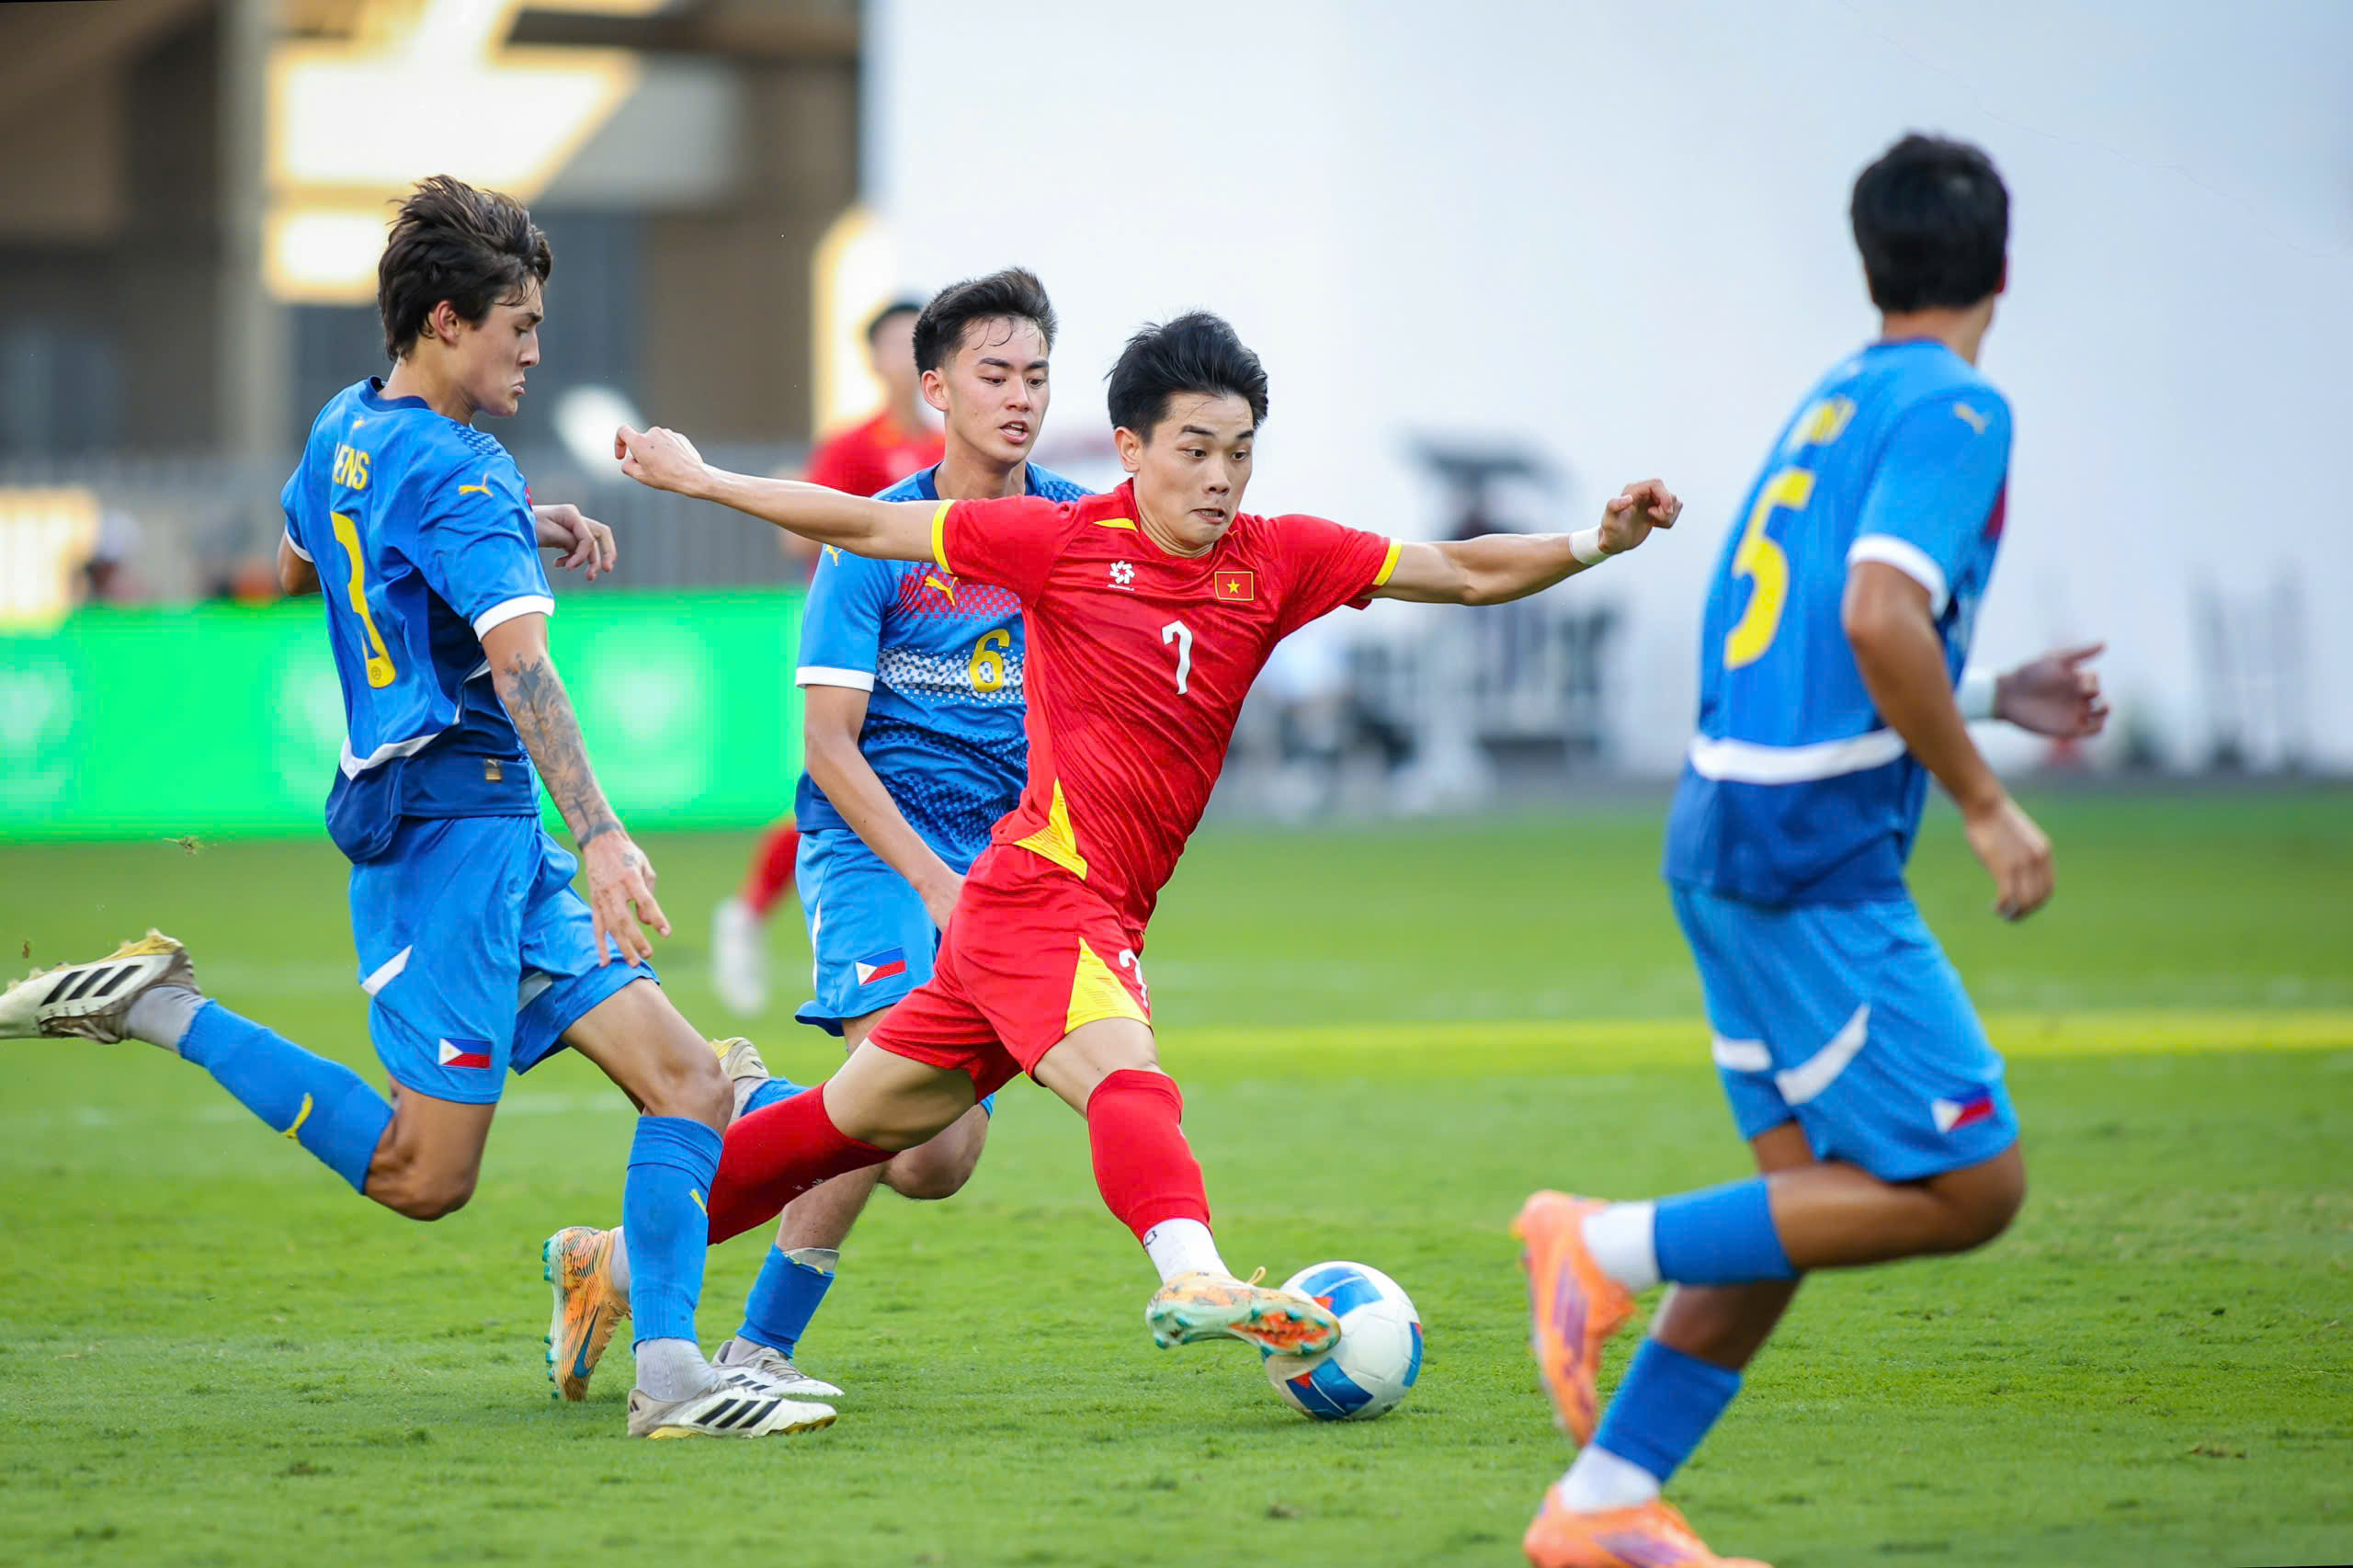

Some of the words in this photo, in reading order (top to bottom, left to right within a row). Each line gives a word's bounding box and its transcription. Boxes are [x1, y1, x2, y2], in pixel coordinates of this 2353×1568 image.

[1723, 467, 1817, 670] 5
[968, 628, 1011, 693] 6
[1161, 619, 1193, 695] 7
